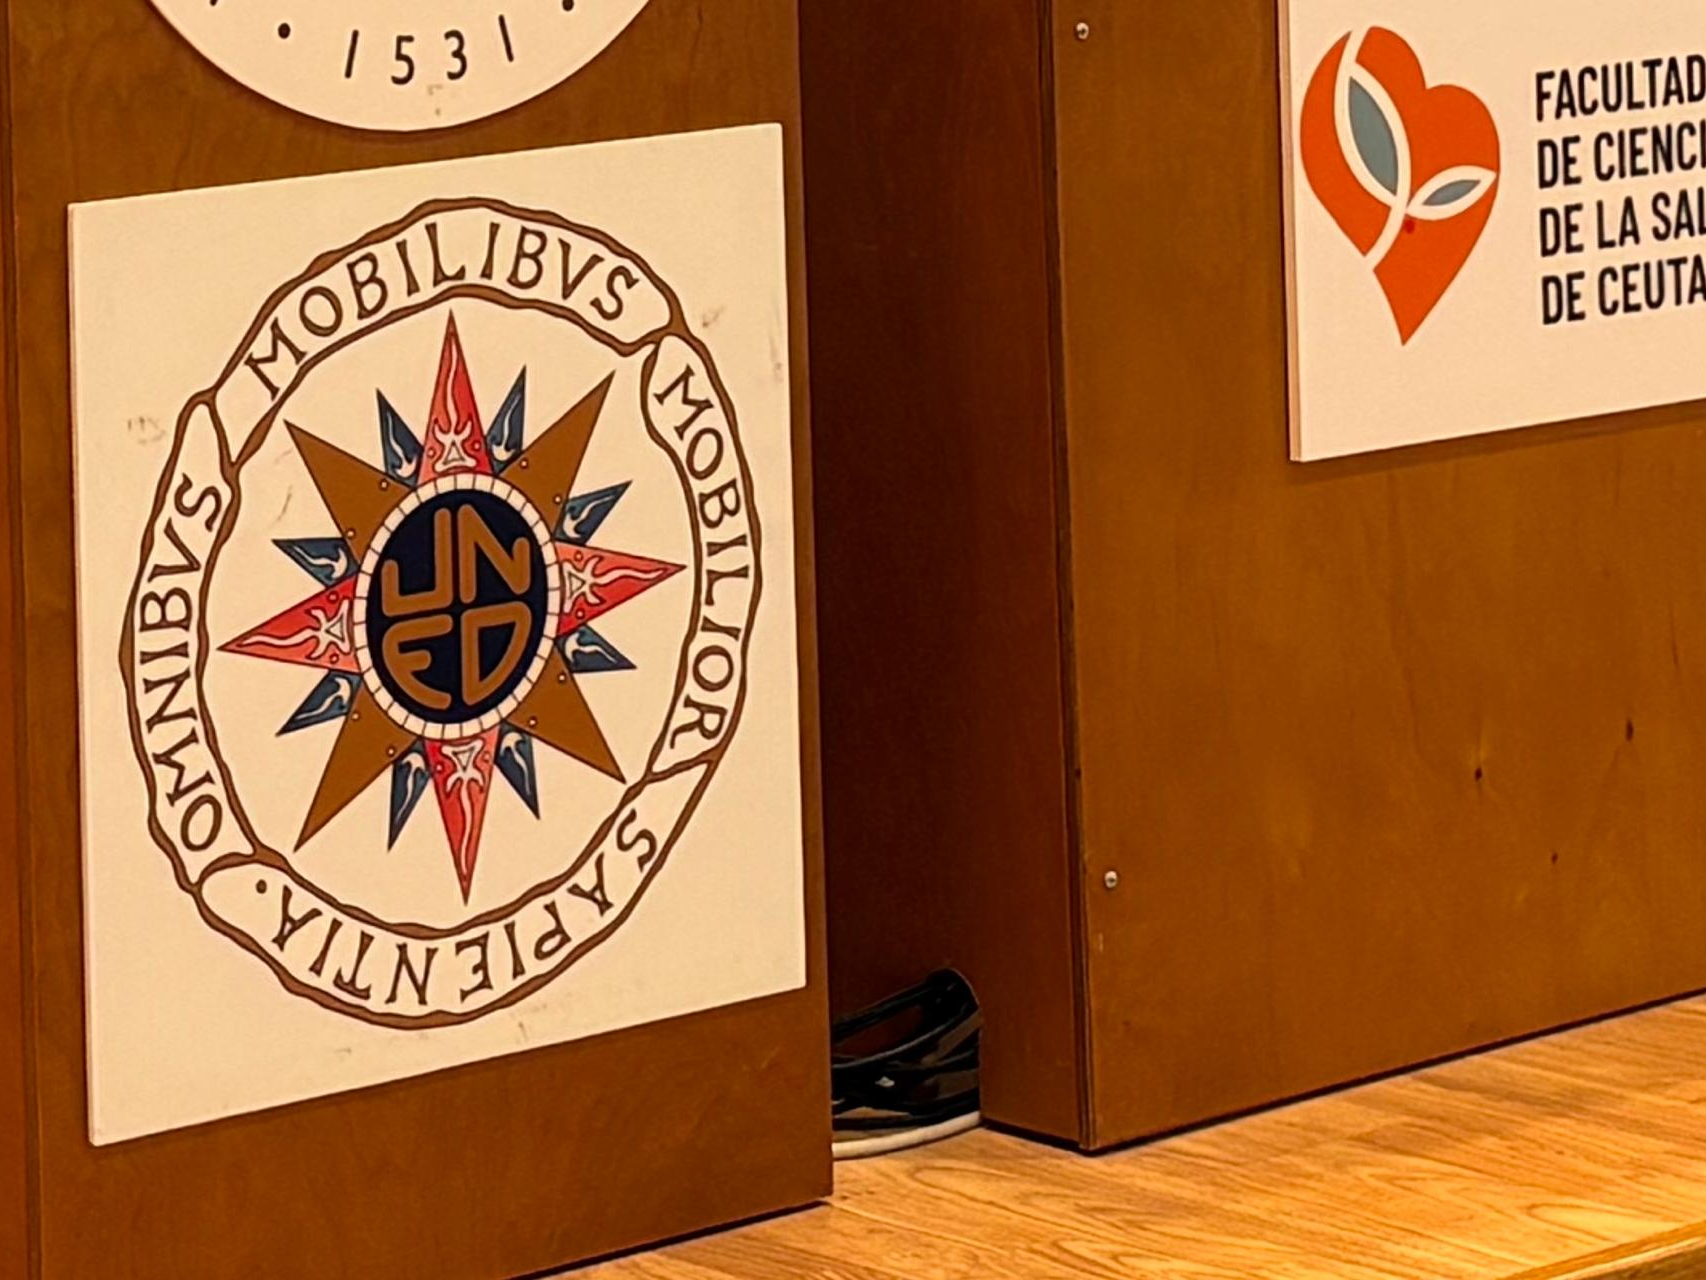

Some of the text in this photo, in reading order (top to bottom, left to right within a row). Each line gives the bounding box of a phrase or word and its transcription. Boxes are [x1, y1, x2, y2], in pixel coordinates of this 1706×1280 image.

[343, 12, 516, 86] 1531
[1535, 53, 1706, 122] FACULTAD
[1537, 136, 1583, 189] DE
[1539, 203, 1584, 258] DE
[1596, 195, 1640, 250] LA
[1541, 271, 1586, 325] DE
[243, 218, 642, 401] MOBILIBVS
[653, 363, 748, 750] MOBILIOR
